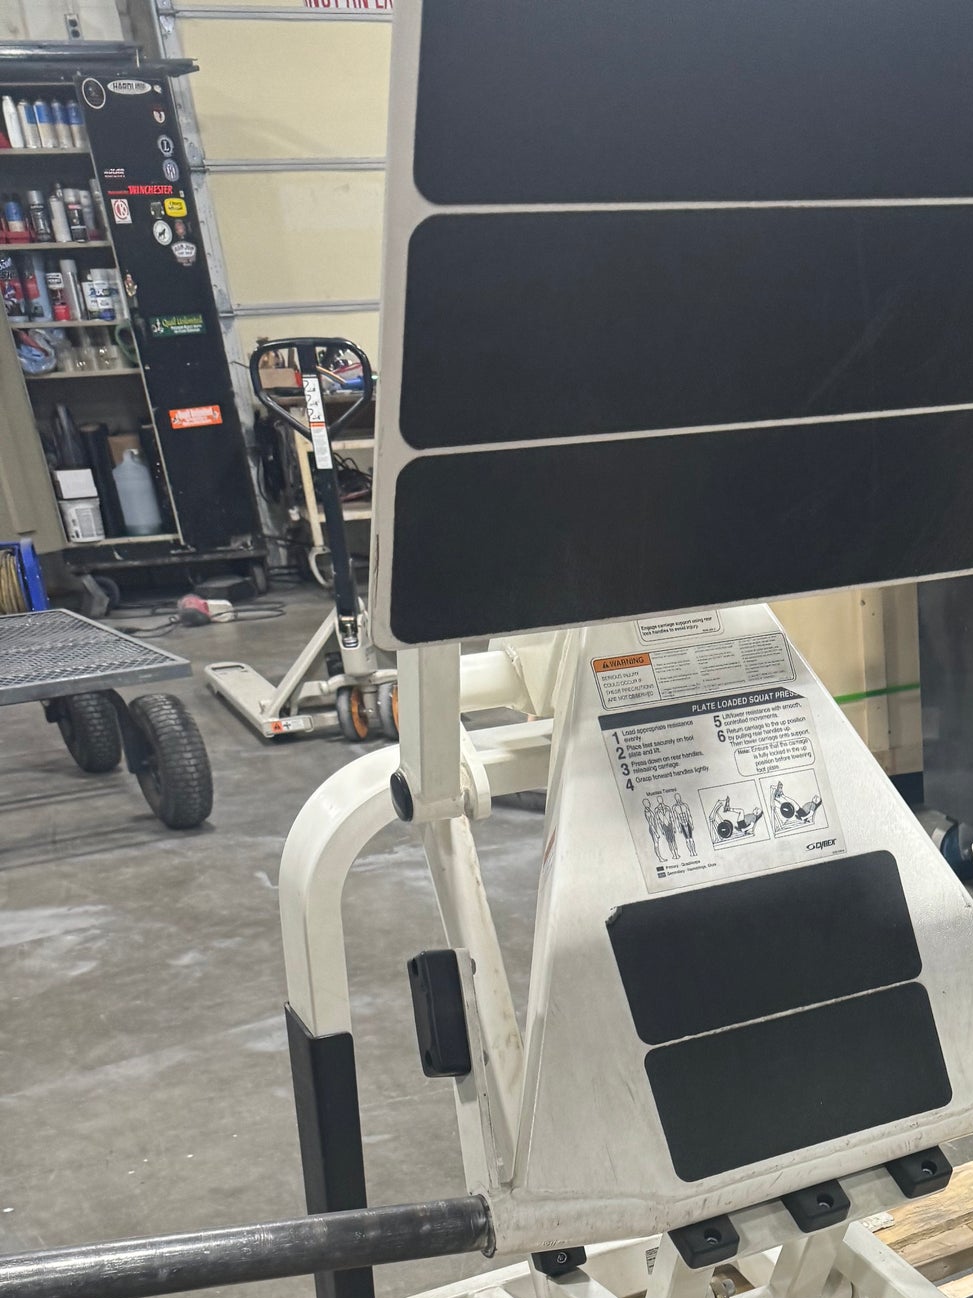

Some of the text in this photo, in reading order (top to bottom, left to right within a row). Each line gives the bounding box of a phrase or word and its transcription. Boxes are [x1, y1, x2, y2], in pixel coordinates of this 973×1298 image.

[128, 185, 173, 194] WINCHESTER
[610, 656, 644, 667] WARNING
[692, 690, 798, 712] PLATE LOADED SQUAT PRES
[713, 715, 722, 727] 5
[612, 732, 619, 744] 1
[717, 730, 726, 742] 6
[616, 746, 625, 759] 2
[621, 763, 630, 776] 3
[625, 778, 634, 791] 4
